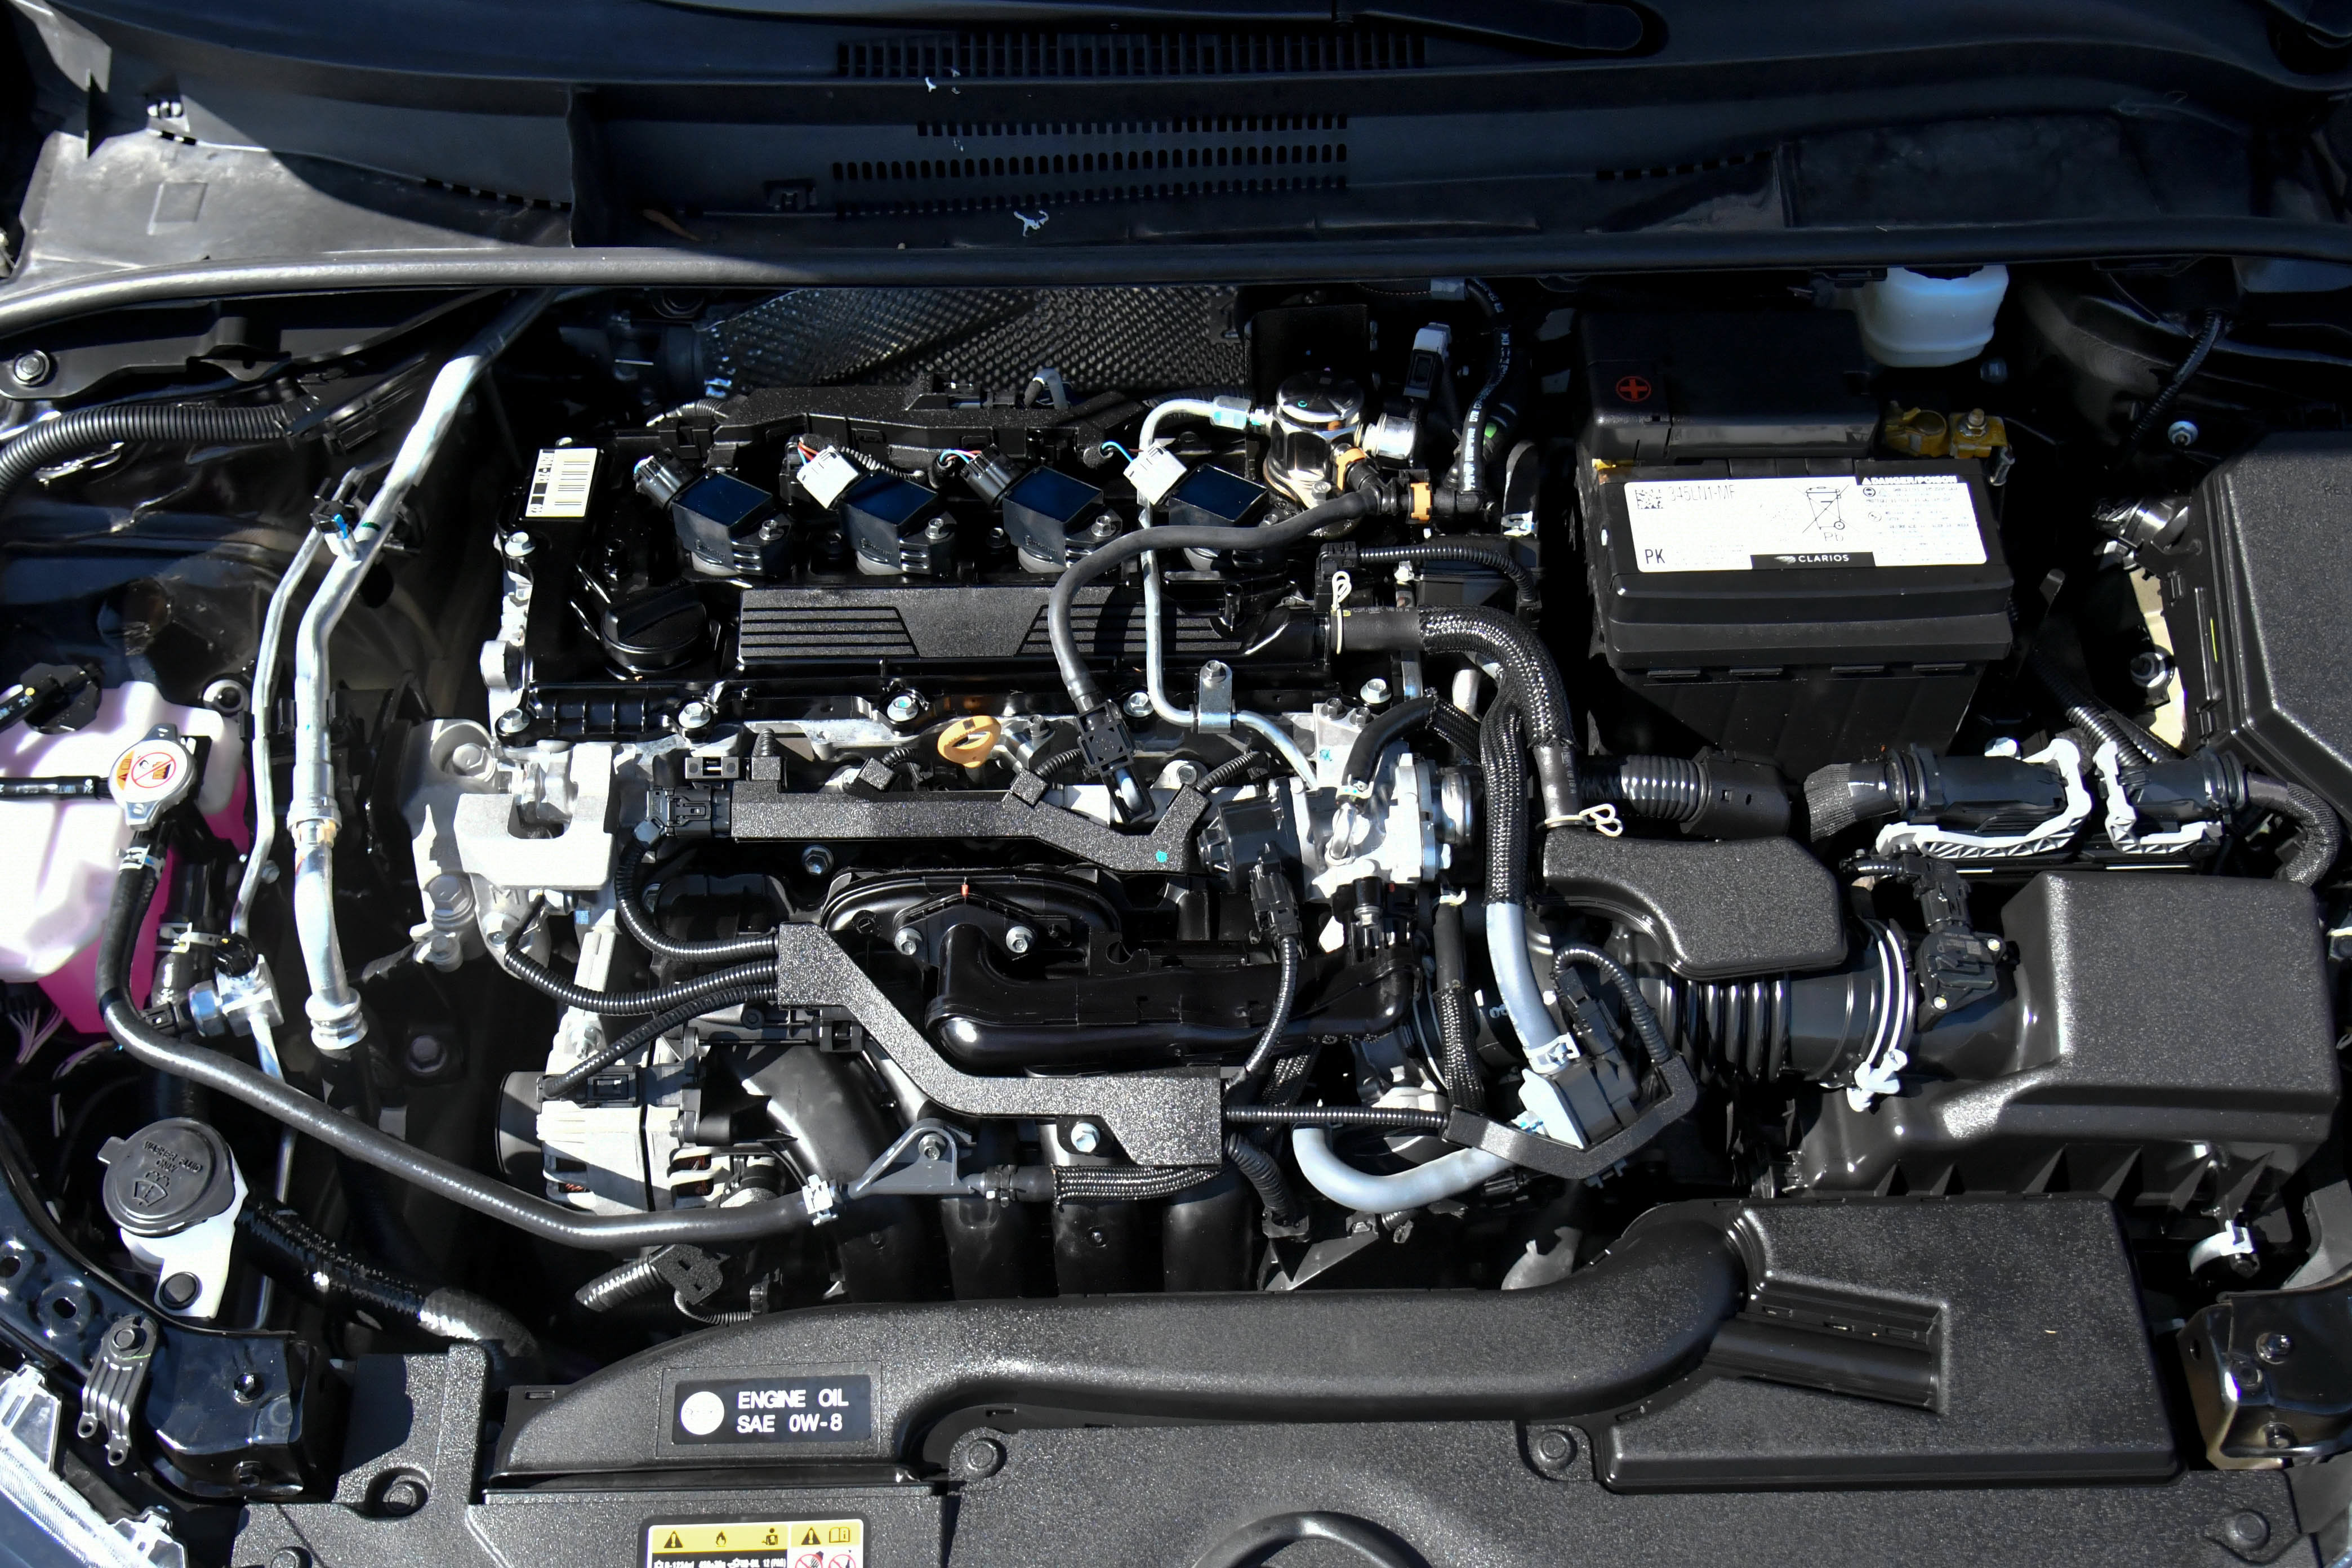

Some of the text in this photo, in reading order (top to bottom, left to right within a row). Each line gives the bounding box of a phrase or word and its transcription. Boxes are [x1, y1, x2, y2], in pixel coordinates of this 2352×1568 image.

[1668, 484, 1735, 501] 345LN1-MF
[1823, 532, 1844, 542] Pb
[1645, 548, 1665, 564] PK
[1798, 554, 1850, 563] CLARIOS
[144, 1141, 203, 1173] WASHER FLUID
[155, 1158, 179, 1173] ONLY
[738, 1388, 849, 1409] ENGINE OIL
[736, 1413, 843, 1433] SAE 0W-8
